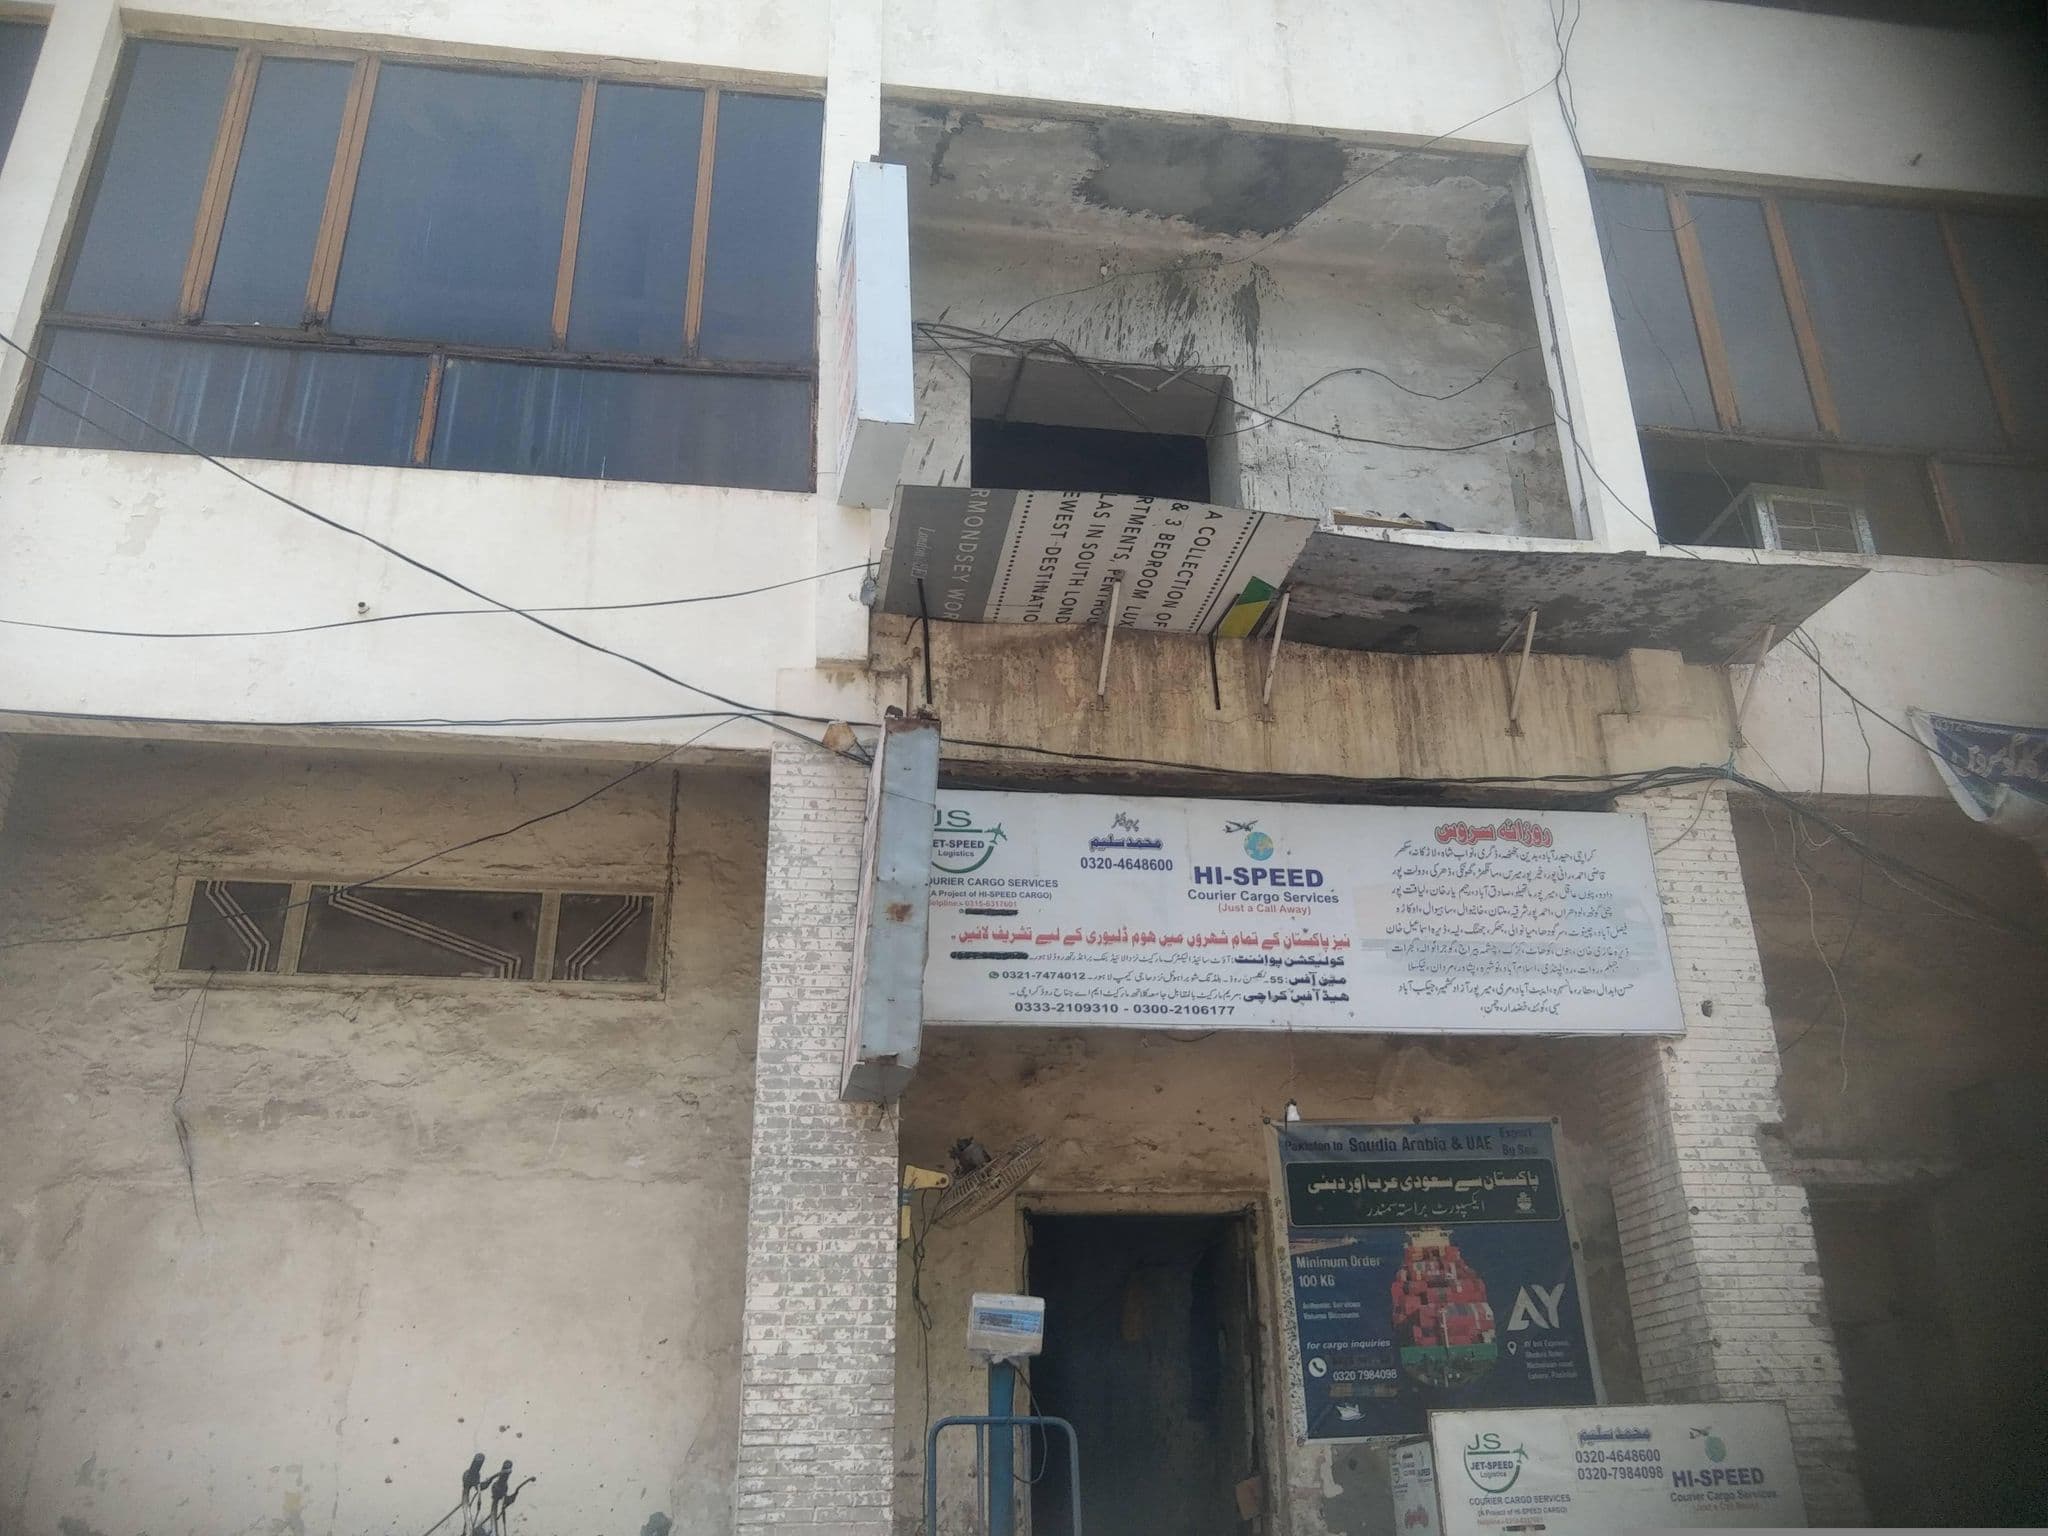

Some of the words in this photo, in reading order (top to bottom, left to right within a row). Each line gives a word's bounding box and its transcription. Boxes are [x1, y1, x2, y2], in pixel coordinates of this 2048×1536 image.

[1170, 502, 1189, 512] &
[1165, 518, 1182, 527] 3
[1204, 510, 1223, 521] A
[1085, 524, 1106, 539] IN
[1068, 542, 1098, 586] SOUTH
[1131, 532, 1176, 600] BEDROOM
[1167, 526, 1216, 609] COLLECTION
[1055, 590, 1080, 624] LOND
[1153, 612, 1172, 629] OF
[1434, 821, 1497, 845] سروس
[932, 839, 985, 849] ET-SPEED
[1089, 833, 1125, 852] سلیم
[1125, 837, 1163, 850] محمد
[938, 850, 975, 858] Logistics
[1080, 857, 1173, 871] 0320-4648600
[967, 878, 1005, 887] CARGO
[1008, 879, 1059, 888] SERVICES
[1194, 866, 1324, 888] HI-SPEED
[941, 890, 967, 899] Project
[968, 890, 977, 898] of
[978, 890, 1017, 899] HI-SPEED
[1019, 891, 1053, 900] CARGO)
[1187, 889, 1237, 901] Courier
[1240, 891, 1280, 904] Cargo
[1283, 892, 1339, 904] Services
[1218, 903, 1244, 914] (Just
[1256, 904, 1276, 913] Call
[1279, 905, 1312, 917] Away)
[992, 925, 1033, 944] تشریف
[1035, 927, 1060, 946] لیے
[1063, 928, 1083, 946] کے
[1159, 932, 1184, 947] میں
[1187, 930, 1229, 948] شہروں
[1231, 931, 1259, 950] تمام
[1261, 932, 1280, 950] کے
[1284, 931, 1329, 952] پاکستان
[1332, 933, 1350, 950] نیز
[1002, 971, 1086, 980] 0321-7474012
[1015, 1002, 1119, 1014] 0333-2109310
[1133, 1004, 1235, 1016] 0300-2106177
[1348, 1137, 1397, 1153] Saudia
[1402, 1136, 1447, 1152] Arabia
[1451, 1136, 1464, 1150] &
[1467, 1135, 1493, 1151] UAE
[1346, 1173, 1366, 1193] اور
[1367, 1177, 1399, 1193] عرب
[1400, 1175, 1453, 1192] سعودی
[1454, 1176, 1483, 1192] سے
[1483, 1170, 1540, 1192] پاکستان
[1296, 1255, 1348, 1269] Minimum
[1350, 1255, 1382, 1267] Order
[1298, 1274, 1318, 1288] 100
[1320, 1274, 1336, 1287] KG
[1507, 1282, 1566, 1331] AY
[1322, 1342, 1349, 1351] cargo
[1351, 1339, 1392, 1350] inquiries
[1333, 1370, 1356, 1382] 0320
[1359, 1368, 1398, 1380] 7984098
[1467, 1433, 1502, 1450] JS
[1575, 1449, 1661, 1464] 0320-4648600
[1470, 1460, 1514, 1471] JET-SPEED
[1577, 1466, 1664, 1481] 0320-7984098
[1671, 1468, 1765, 1488] HI-SPEED
[1469, 1497, 1504, 1506] COURIER
[1504, 1495, 1532, 1505] CARGO
[1533, 1493, 1571, 1504] SERVICES
[1669, 1491, 1705, 1503] Courier
